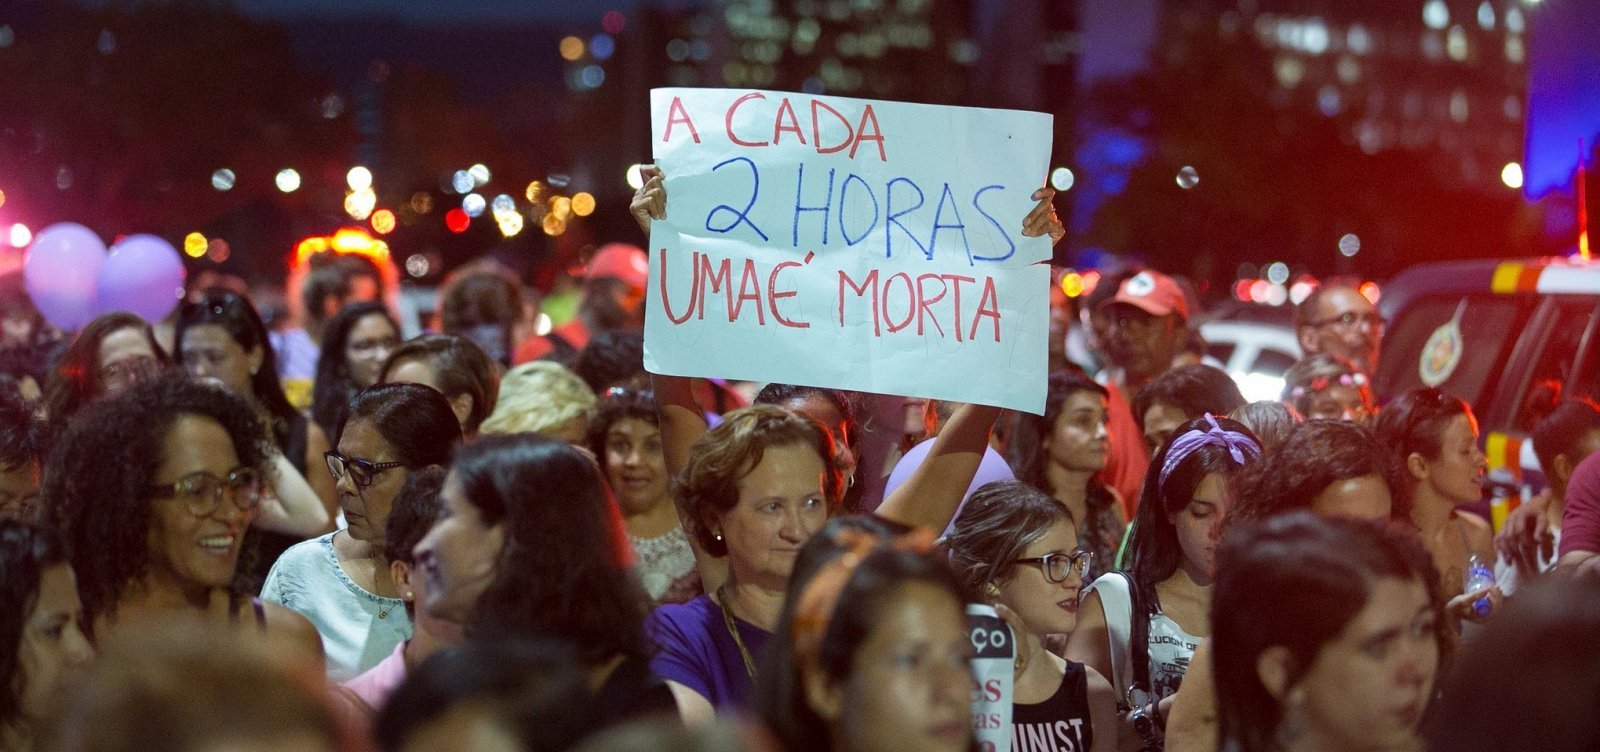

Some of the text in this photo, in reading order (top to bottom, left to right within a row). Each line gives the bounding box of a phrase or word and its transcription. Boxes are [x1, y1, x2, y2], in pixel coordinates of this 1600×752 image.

[664, 92, 887, 162] A CADA
[706, 156, 1016, 267] 2 HORAS
[838, 269, 1001, 343] MORTA
